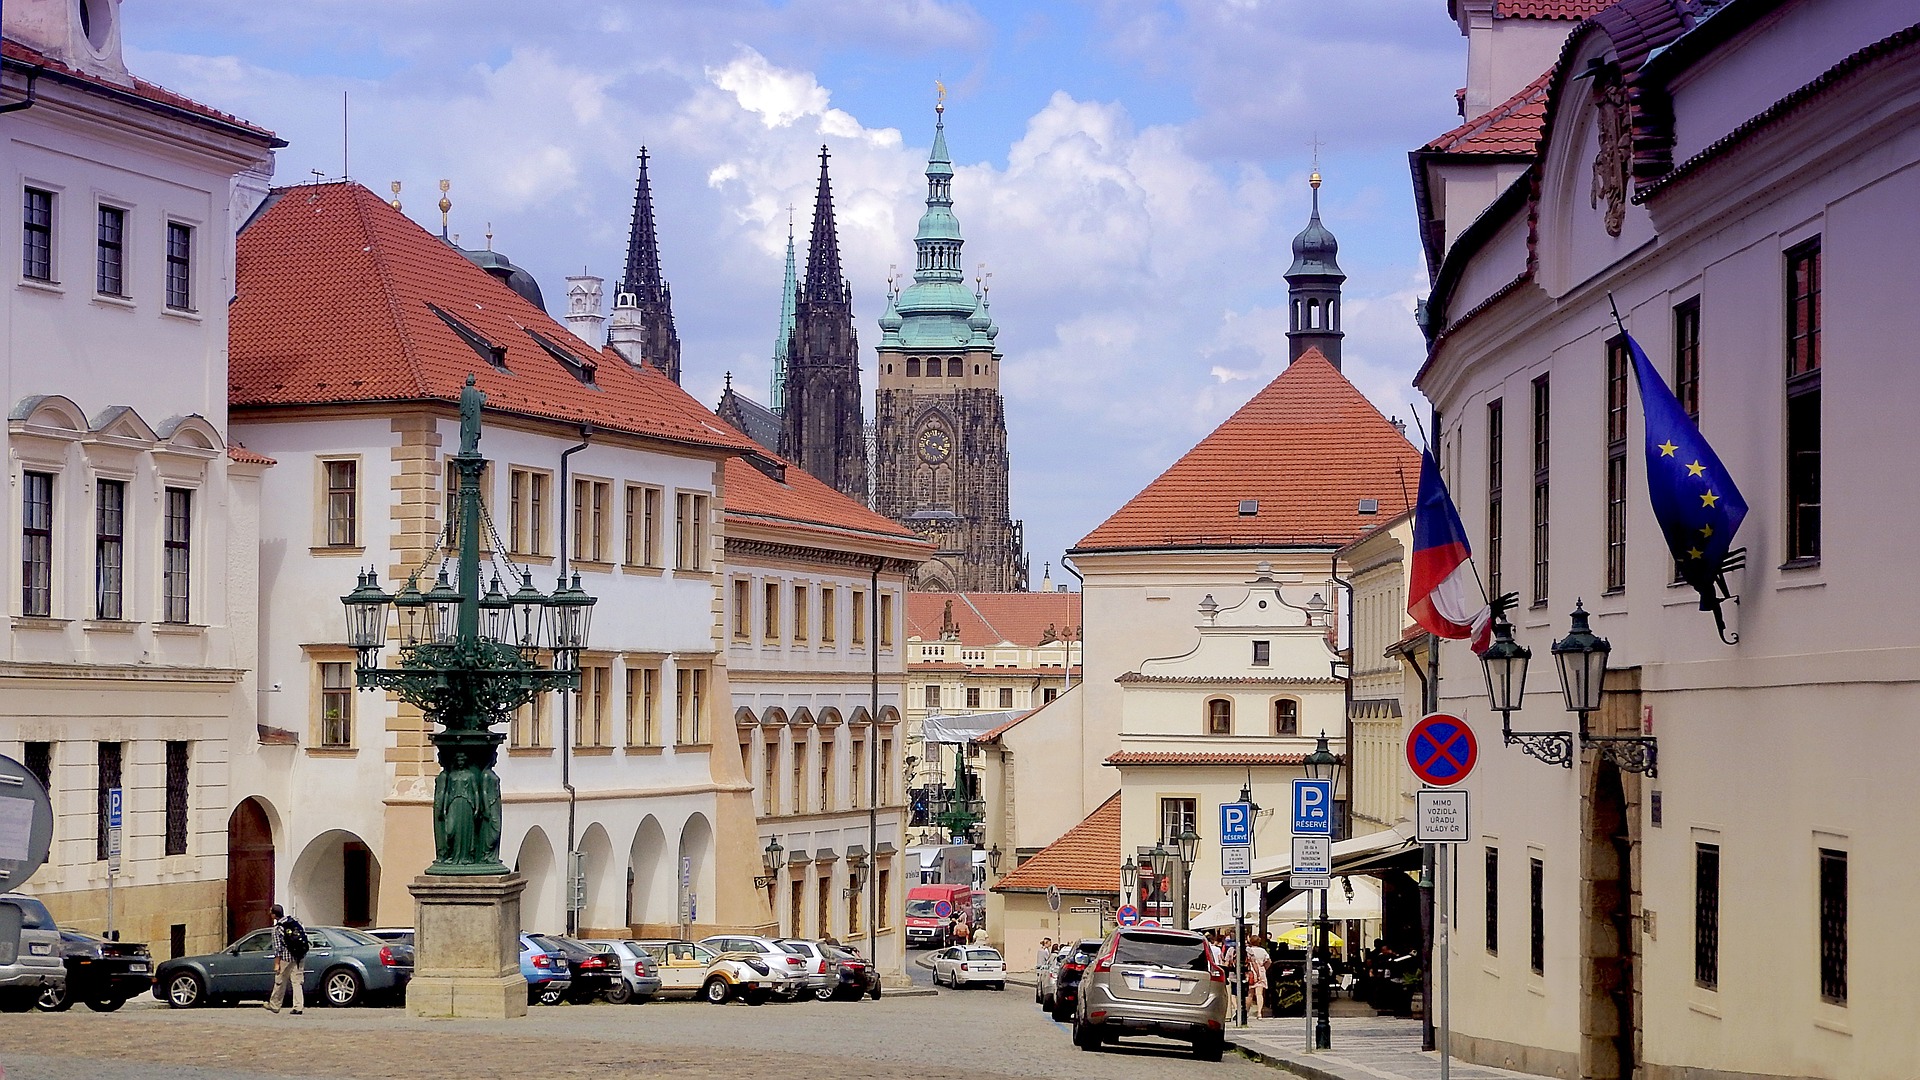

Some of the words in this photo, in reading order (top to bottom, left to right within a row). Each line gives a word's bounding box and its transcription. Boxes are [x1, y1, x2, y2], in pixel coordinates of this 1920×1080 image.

[112, 793, 120, 816] P
[1301, 786, 1322, 817] P
[1226, 808, 1243, 833] P
[1295, 819, 1327, 828] RÉSERVÉ
[1430, 815, 1455, 824] ÚŘADU
[1450, 824, 1460, 832] ČR
